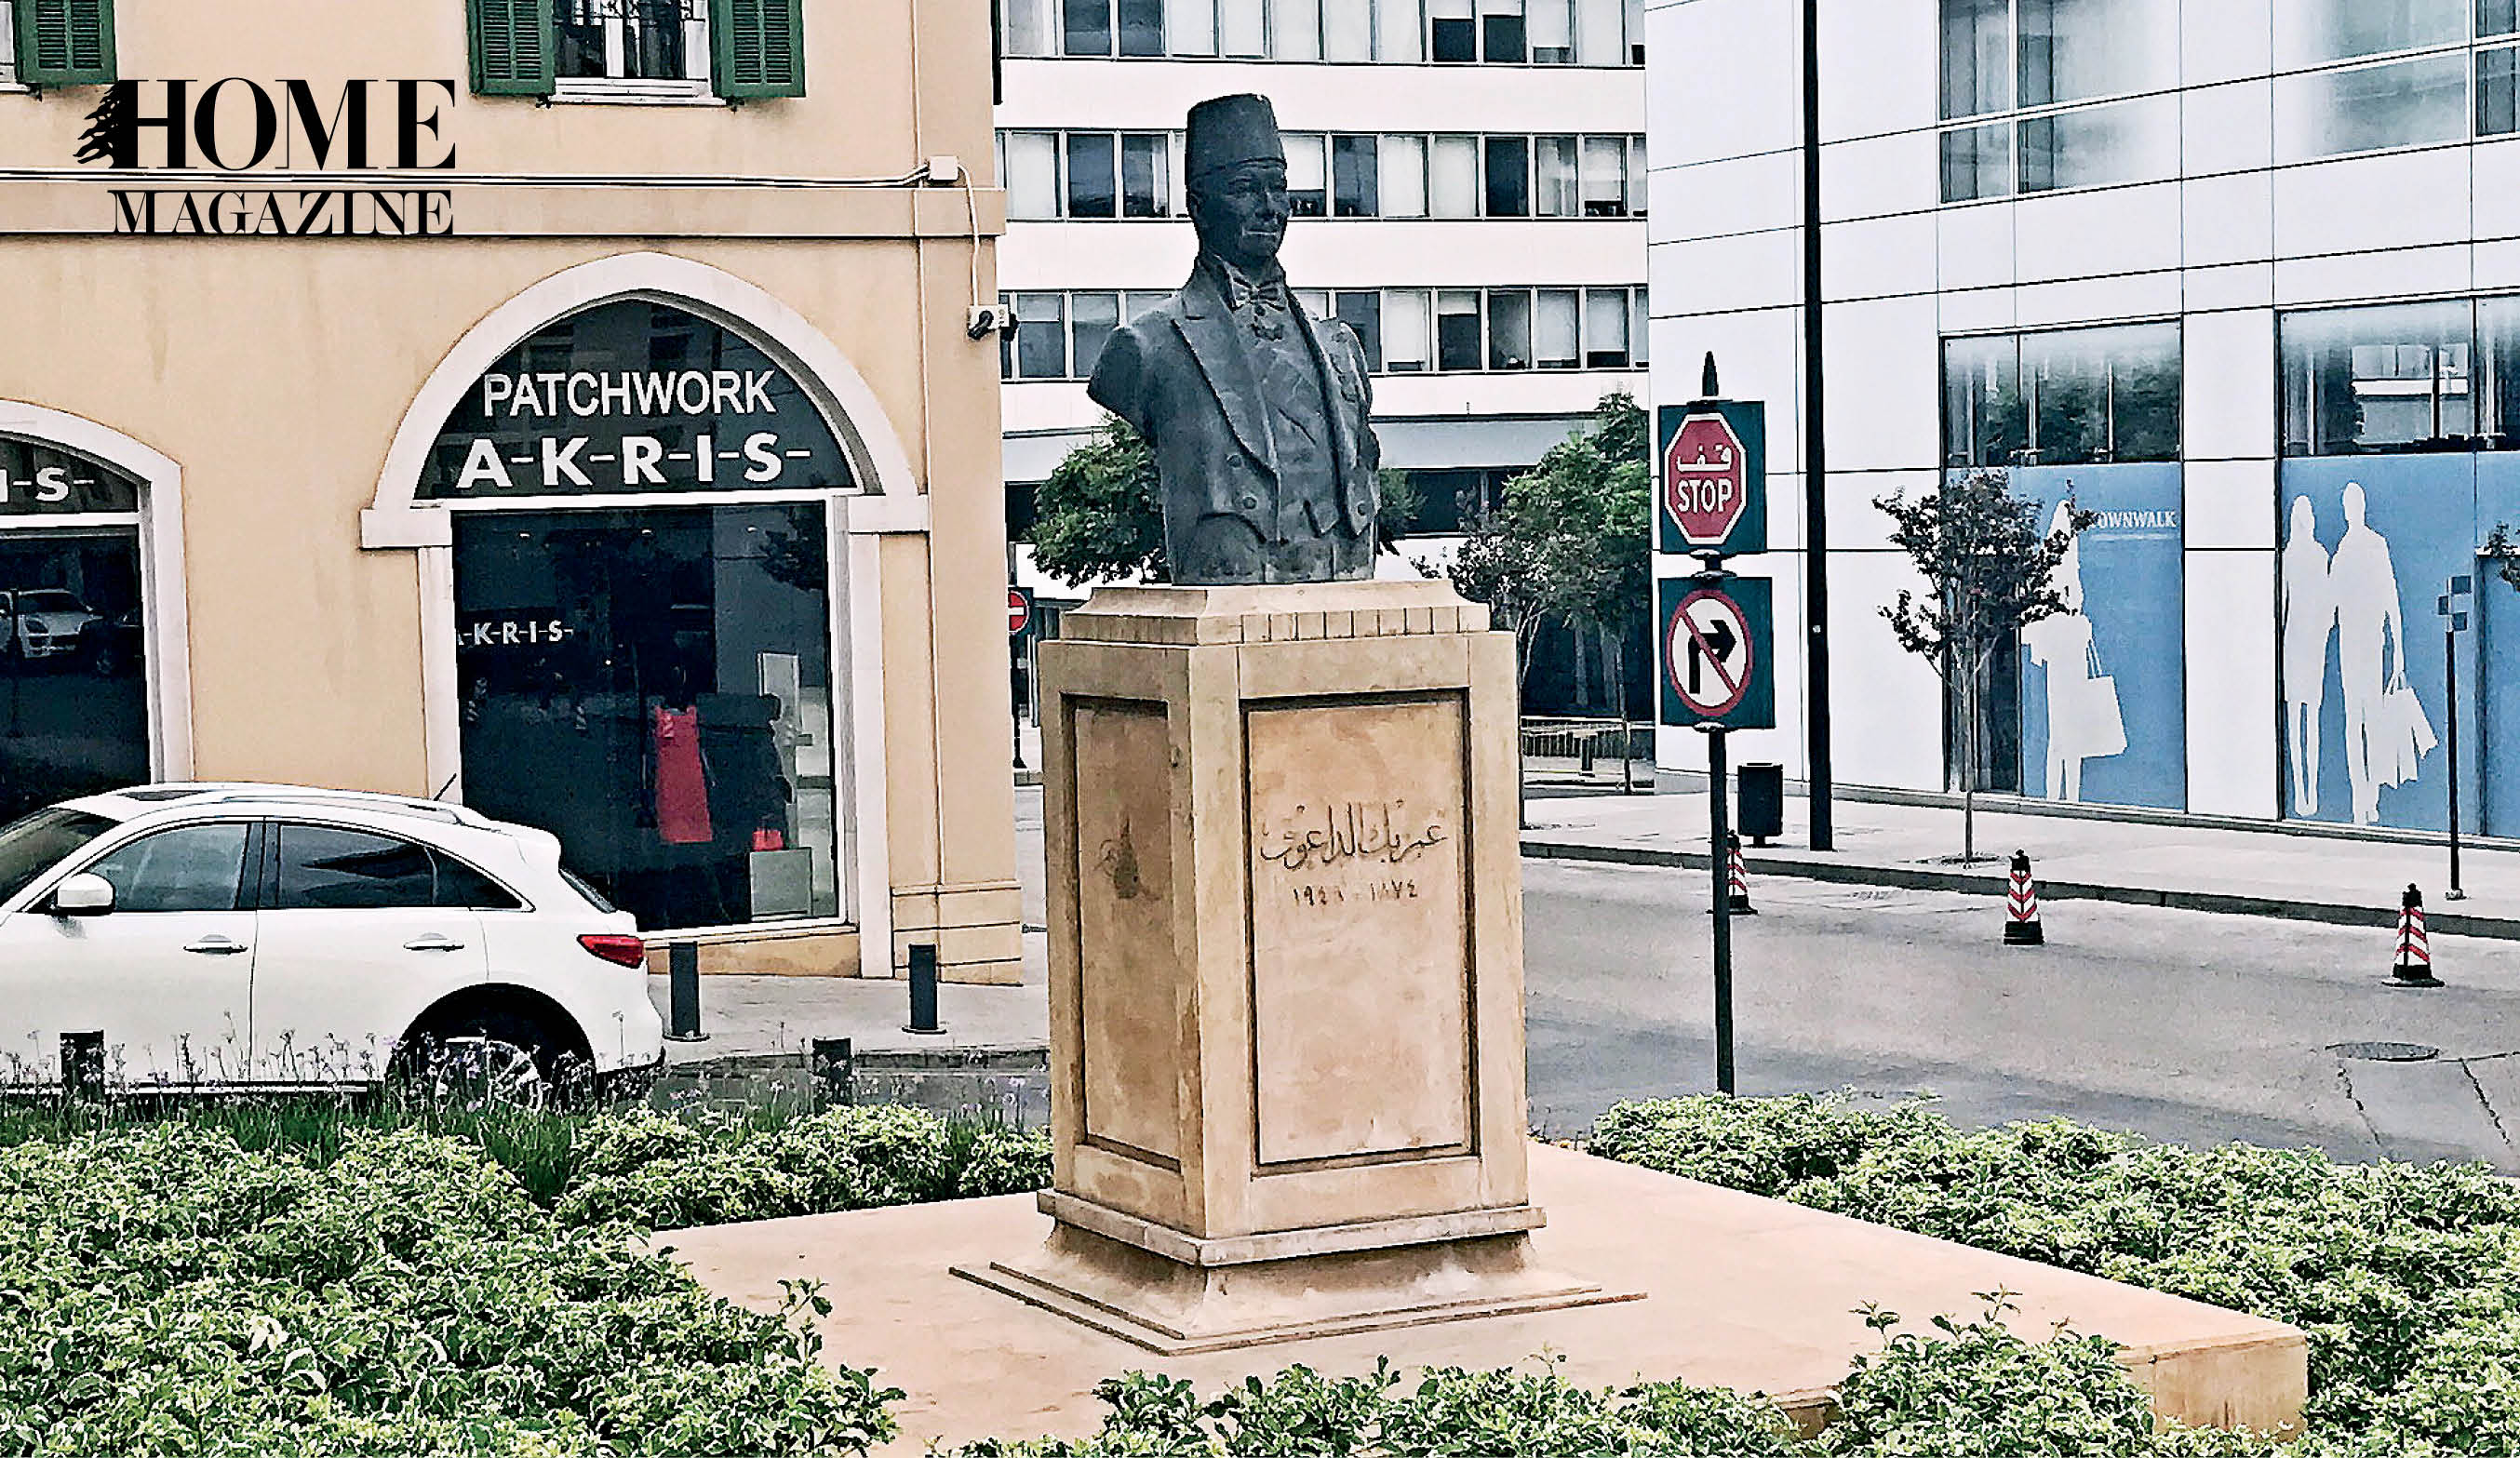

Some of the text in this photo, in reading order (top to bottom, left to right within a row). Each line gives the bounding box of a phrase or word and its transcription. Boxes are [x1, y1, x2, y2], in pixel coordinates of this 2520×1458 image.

[484, 369, 778, 417] PATCHWORK
[1676, 444, 1733, 472] قف
[1677, 478, 1734, 514] STOP
[2089, 510, 2177, 529] OWNWALK
[1389, 810, 1448, 863] عمر
